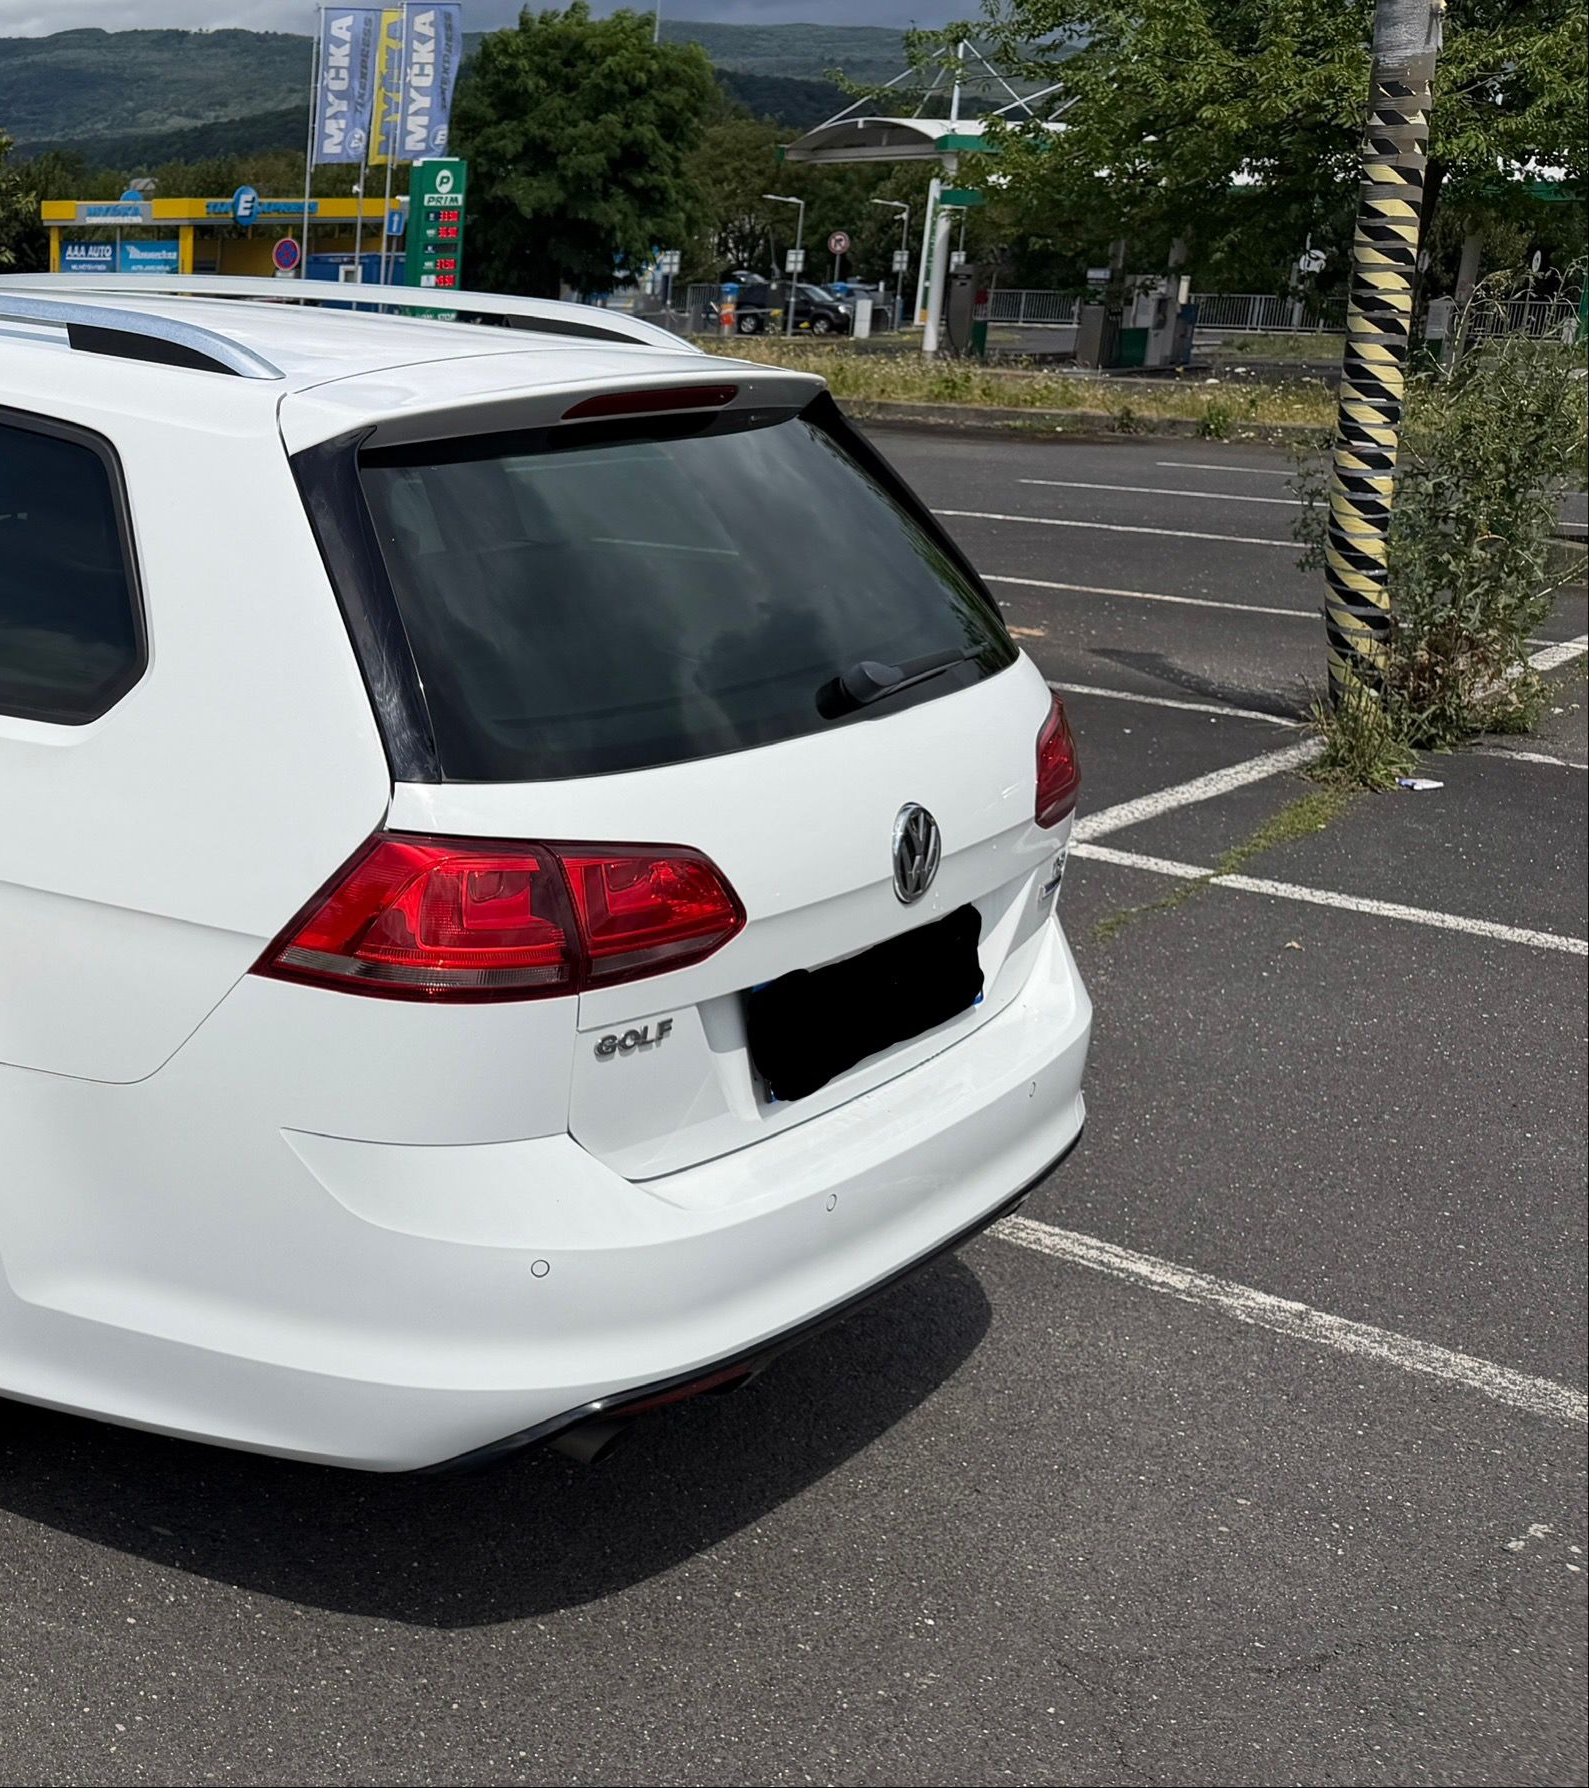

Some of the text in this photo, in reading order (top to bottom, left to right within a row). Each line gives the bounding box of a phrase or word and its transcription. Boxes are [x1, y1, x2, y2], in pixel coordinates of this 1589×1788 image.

[323, 14, 355, 155] MYČKA
[405, 9, 436, 151] MYČKA
[426, 195, 460, 206] PRIM
[65, 245, 87, 258] AAA
[87, 245, 113, 258] AUTO
[594, 1018, 673, 1056] GOLF
